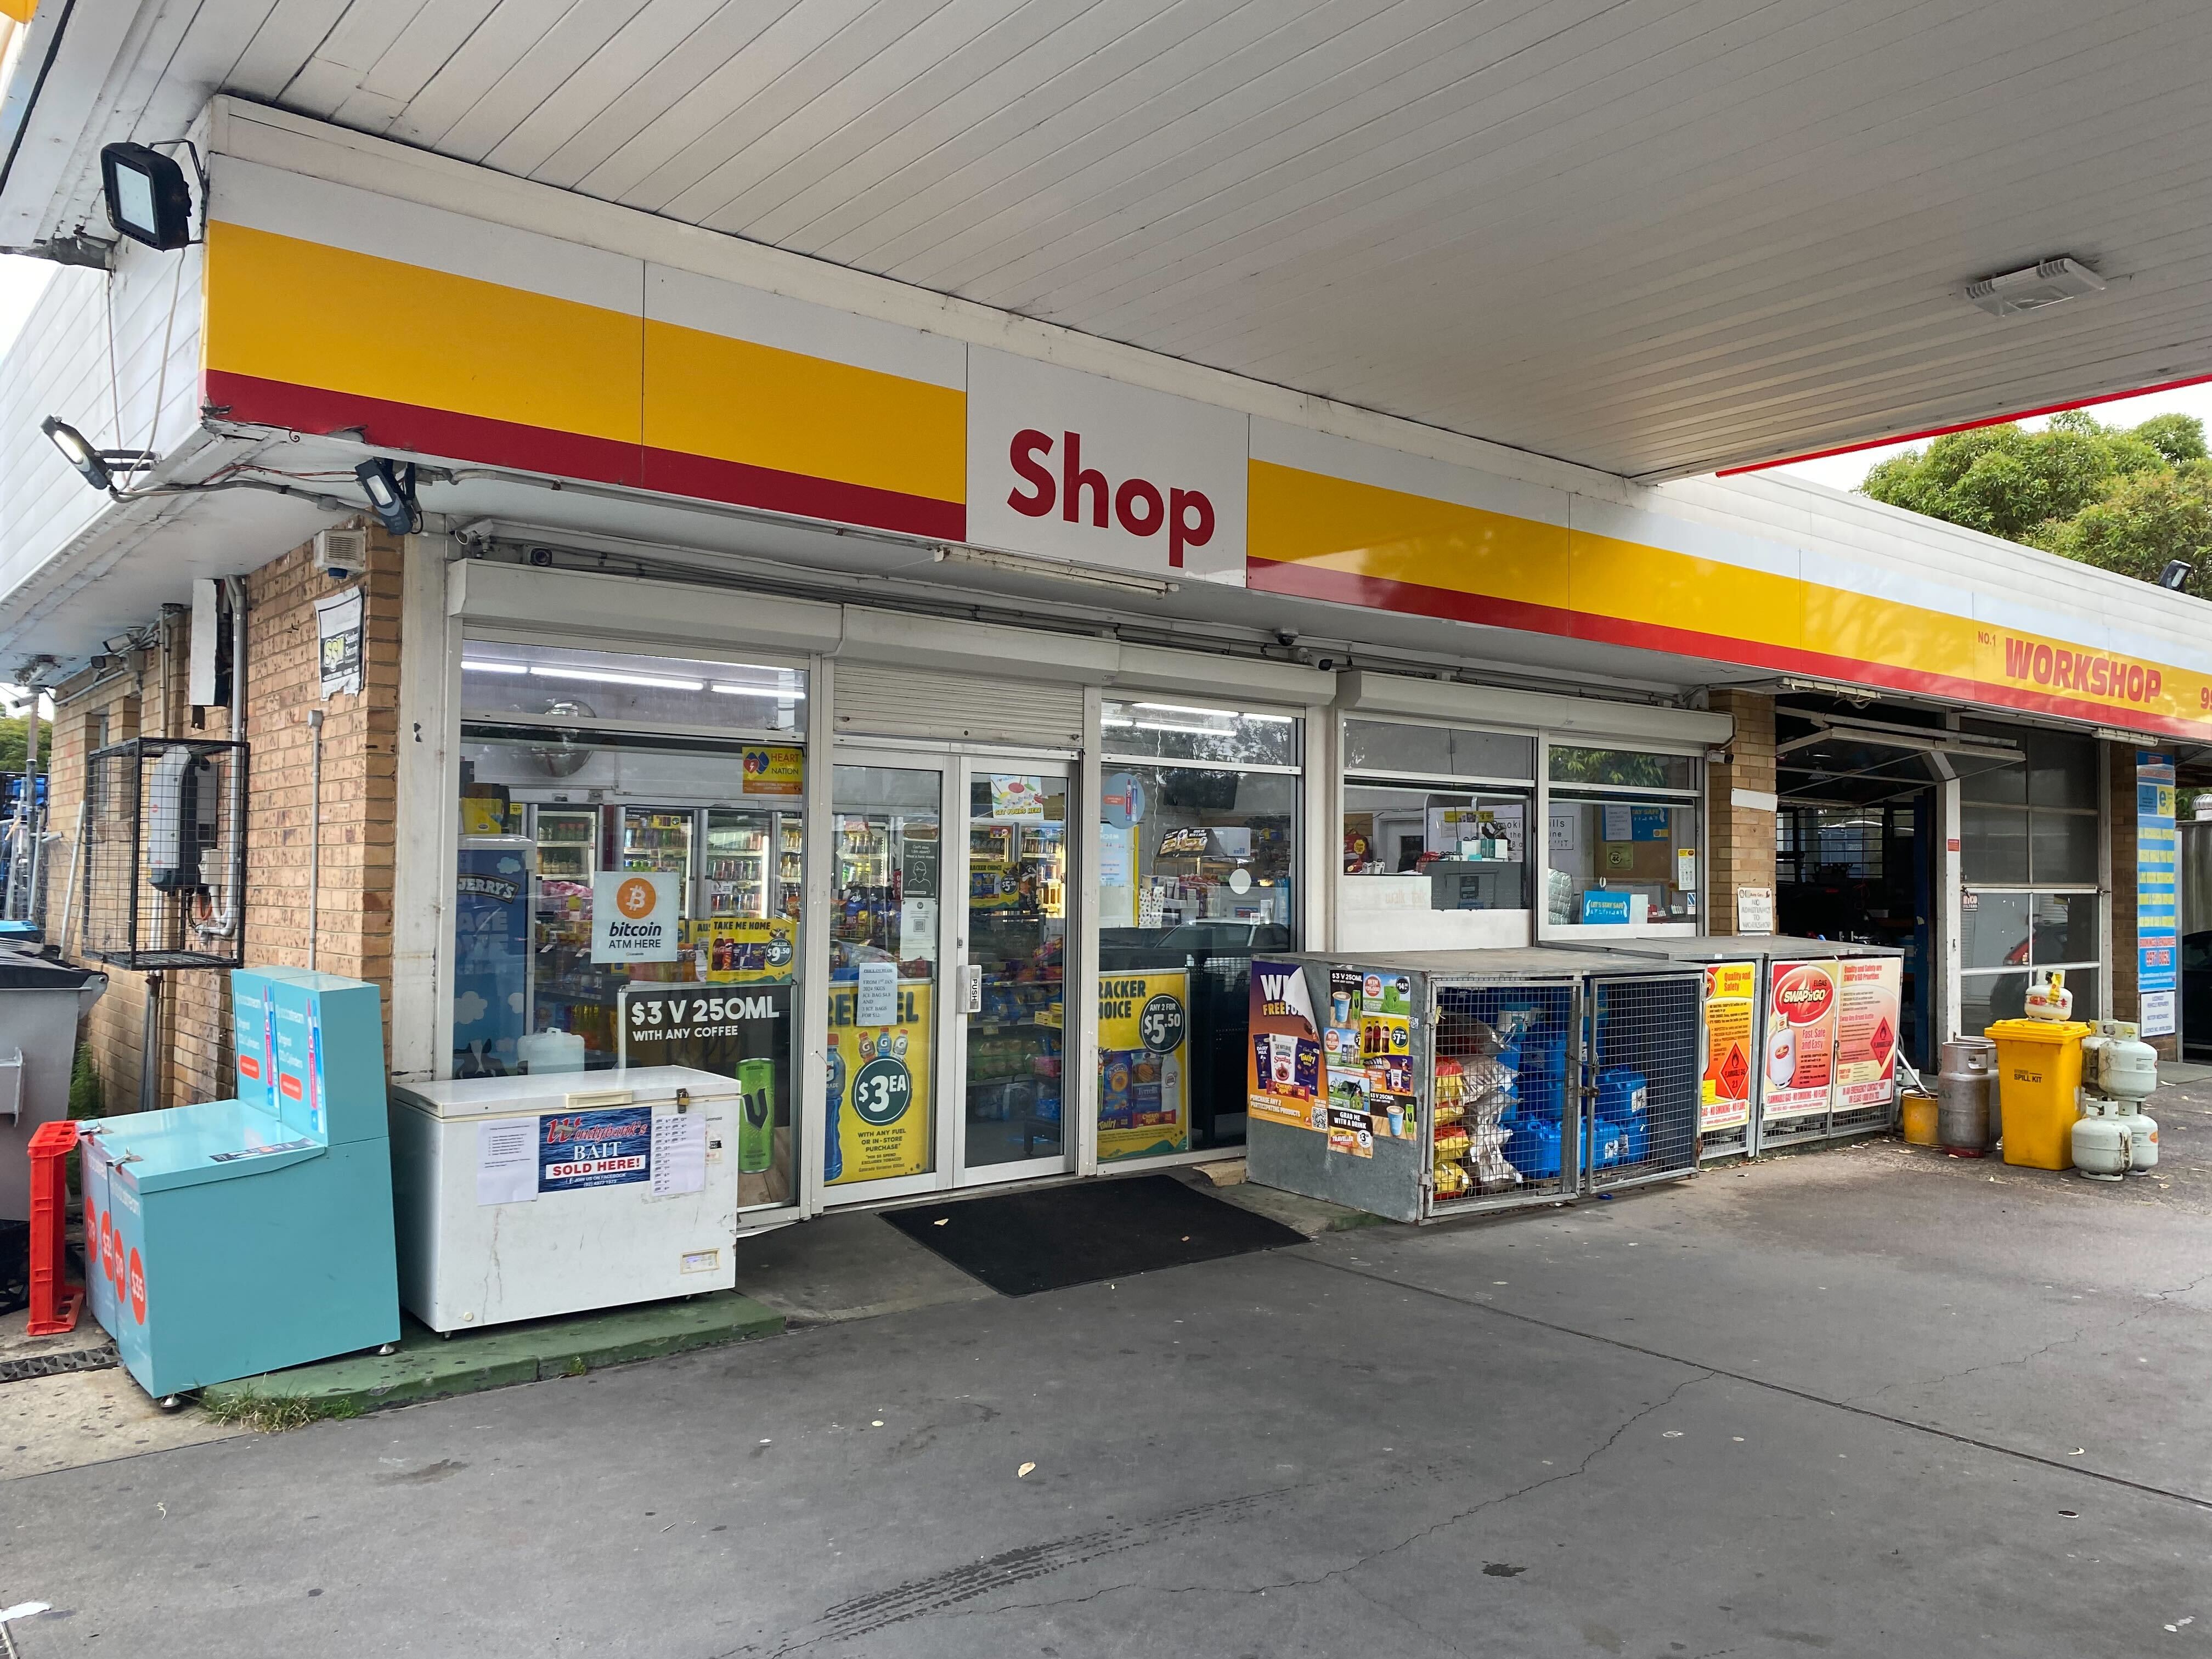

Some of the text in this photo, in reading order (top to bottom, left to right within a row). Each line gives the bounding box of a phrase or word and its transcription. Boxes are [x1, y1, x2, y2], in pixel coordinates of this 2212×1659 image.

[1007, 429, 1215, 568] Shop
[1978, 631, 1996, 646] NO.1
[2006, 637, 2161, 703] WORKSHOP
[2200, 687, 2212, 709] 9
[771, 753, 799, 762] HEART
[458, 878, 514, 898] JERRY'S
[609, 922, 662, 936] bitcoin
[714, 922, 771, 930] TAKE ME HOME
[609, 939, 661, 948] ATM HERE
[768, 946, 790, 961] $9.50
[1844, 966, 1857, 974] Quality
[1865, 964, 1876, 973] Safety
[1724, 971, 1751, 981] Quality and
[1724, 983, 1739, 991] Safety
[631, 996, 779, 1025] $3 V 250ML
[633, 1025, 737, 1041] WITH ANY COFFEE
[1144, 1014, 1181, 1043] $5.50
[1815, 1028, 1826, 1037] Safe
[862, 1042, 870, 1051] G
[881, 1039, 888, 1047] G
[898, 1039, 905, 1048] G
[1801, 1040, 1824, 1049] and Easy
[1299, 1053, 1316, 1064] Twirl
[2014, 1074, 2030, 1082] SPILL
[859, 1075, 906, 1112] $3 EA
[742, 1087, 768, 1131] V
[1711, 1107, 1715, 1115] NO
[1716, 1104, 1730, 1114] SMOKING
[1733, 1103, 1737, 1112] NO
[1737, 1102, 1746, 1110] FLAME
[1352, 1120, 1366, 1129] DRINK
[573, 1142, 622, 1161] BAIT
[553, 1158, 640, 1176] SOLD HERE!
[132, 1270, 144, 1302] $35
